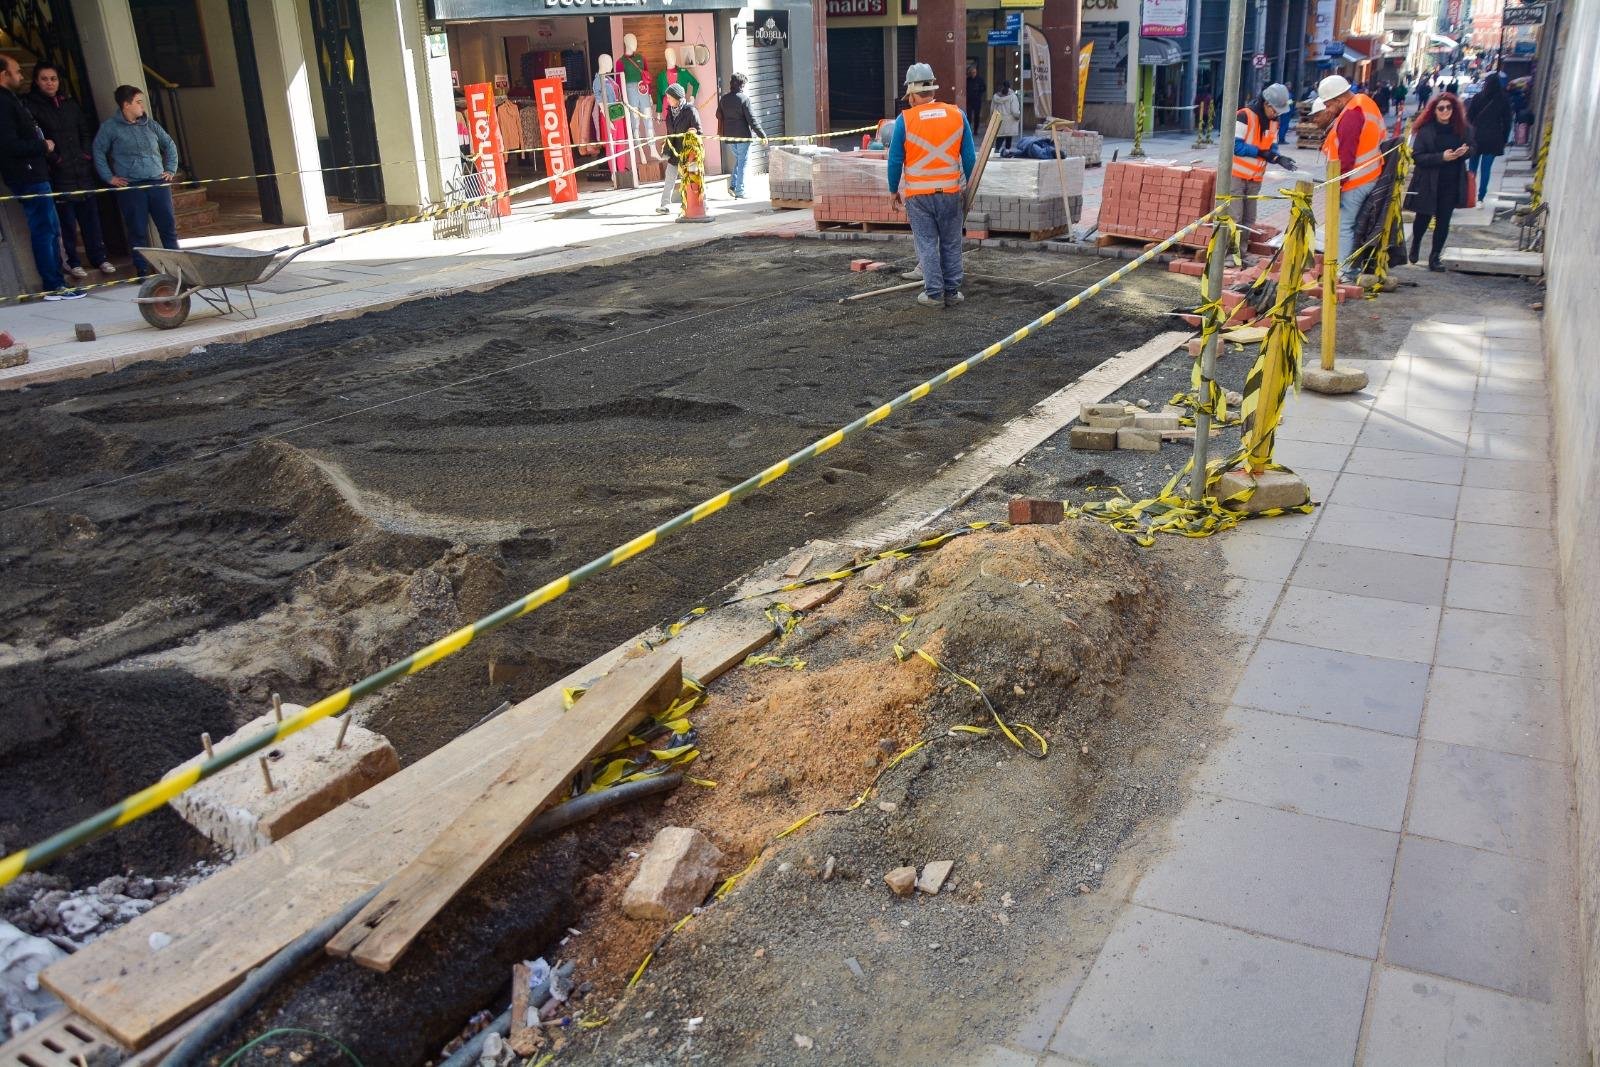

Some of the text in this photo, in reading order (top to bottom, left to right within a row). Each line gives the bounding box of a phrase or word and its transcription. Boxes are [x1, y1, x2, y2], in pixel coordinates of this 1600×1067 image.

[826, 0, 882, 13] nald's
[1081, 0, 1119, 9] CON
[768, 30, 787, 39] BELLA
[471, 92, 498, 195] LIQUID
[541, 86, 567, 194] LIQUIDA
